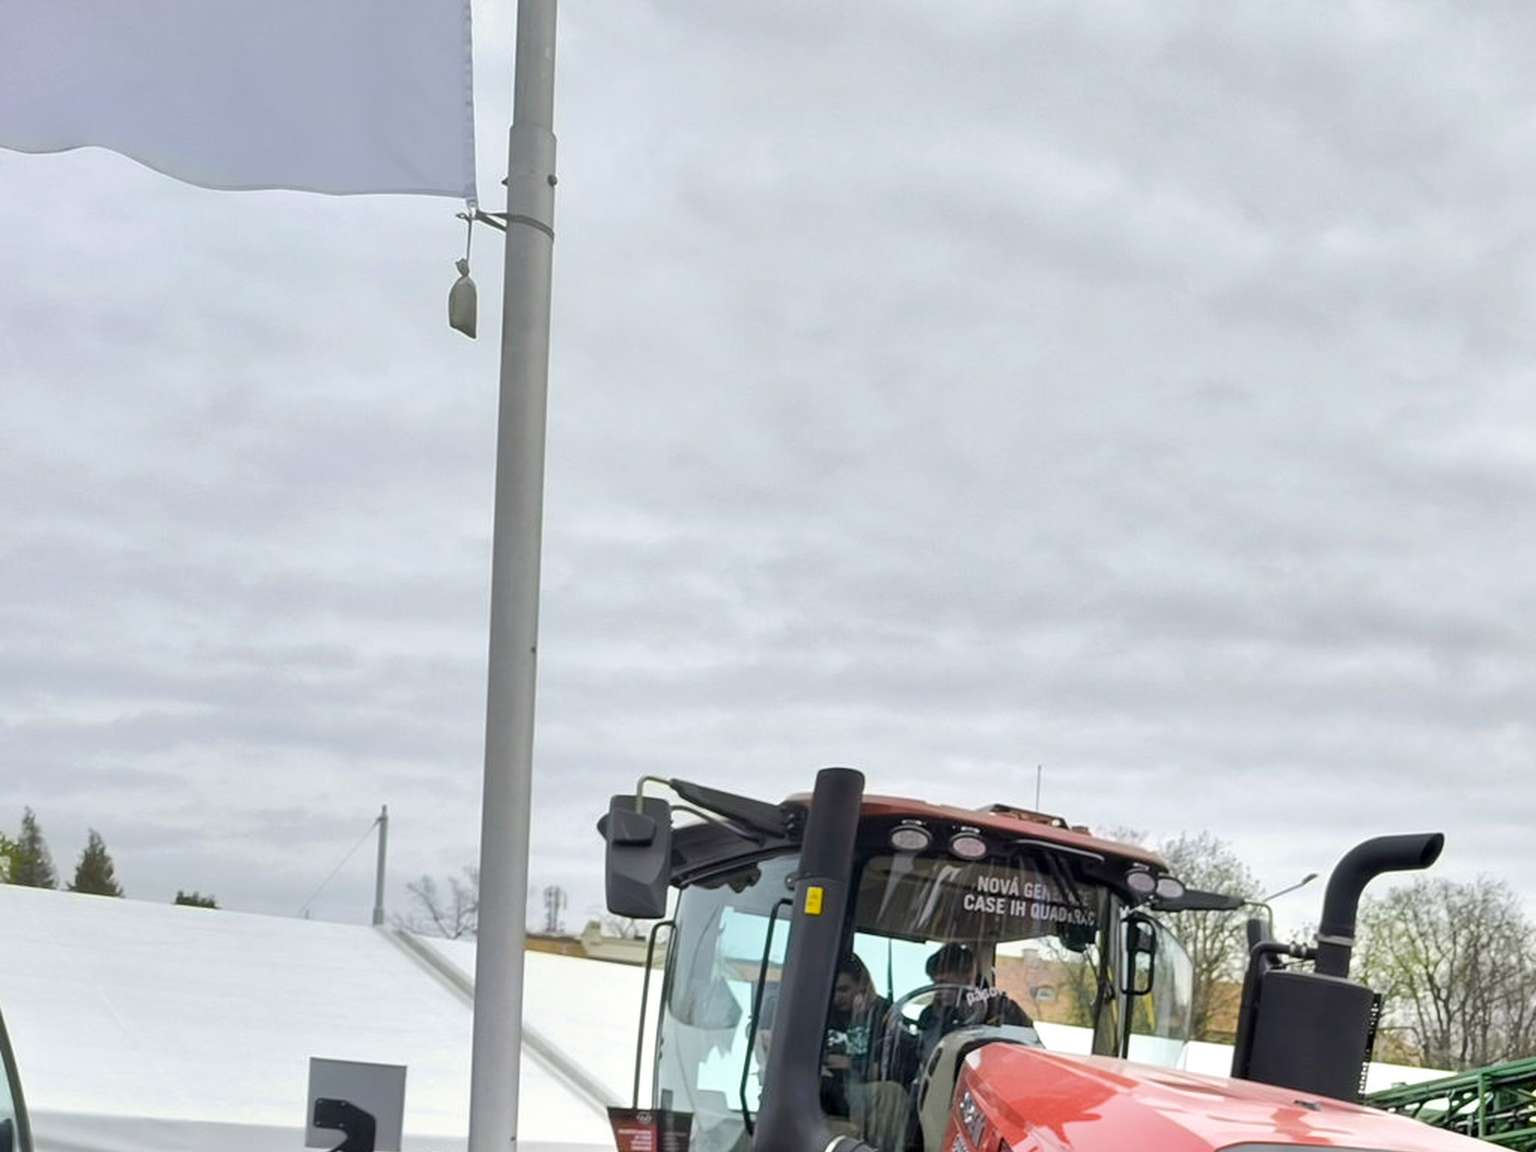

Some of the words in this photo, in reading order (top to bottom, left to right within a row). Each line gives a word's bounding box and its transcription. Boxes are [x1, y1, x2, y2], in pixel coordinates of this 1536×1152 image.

[977, 876, 1019, 896] NOVÁ
[964, 894, 1006, 915] CASE
[1010, 899, 1026, 917] IH
